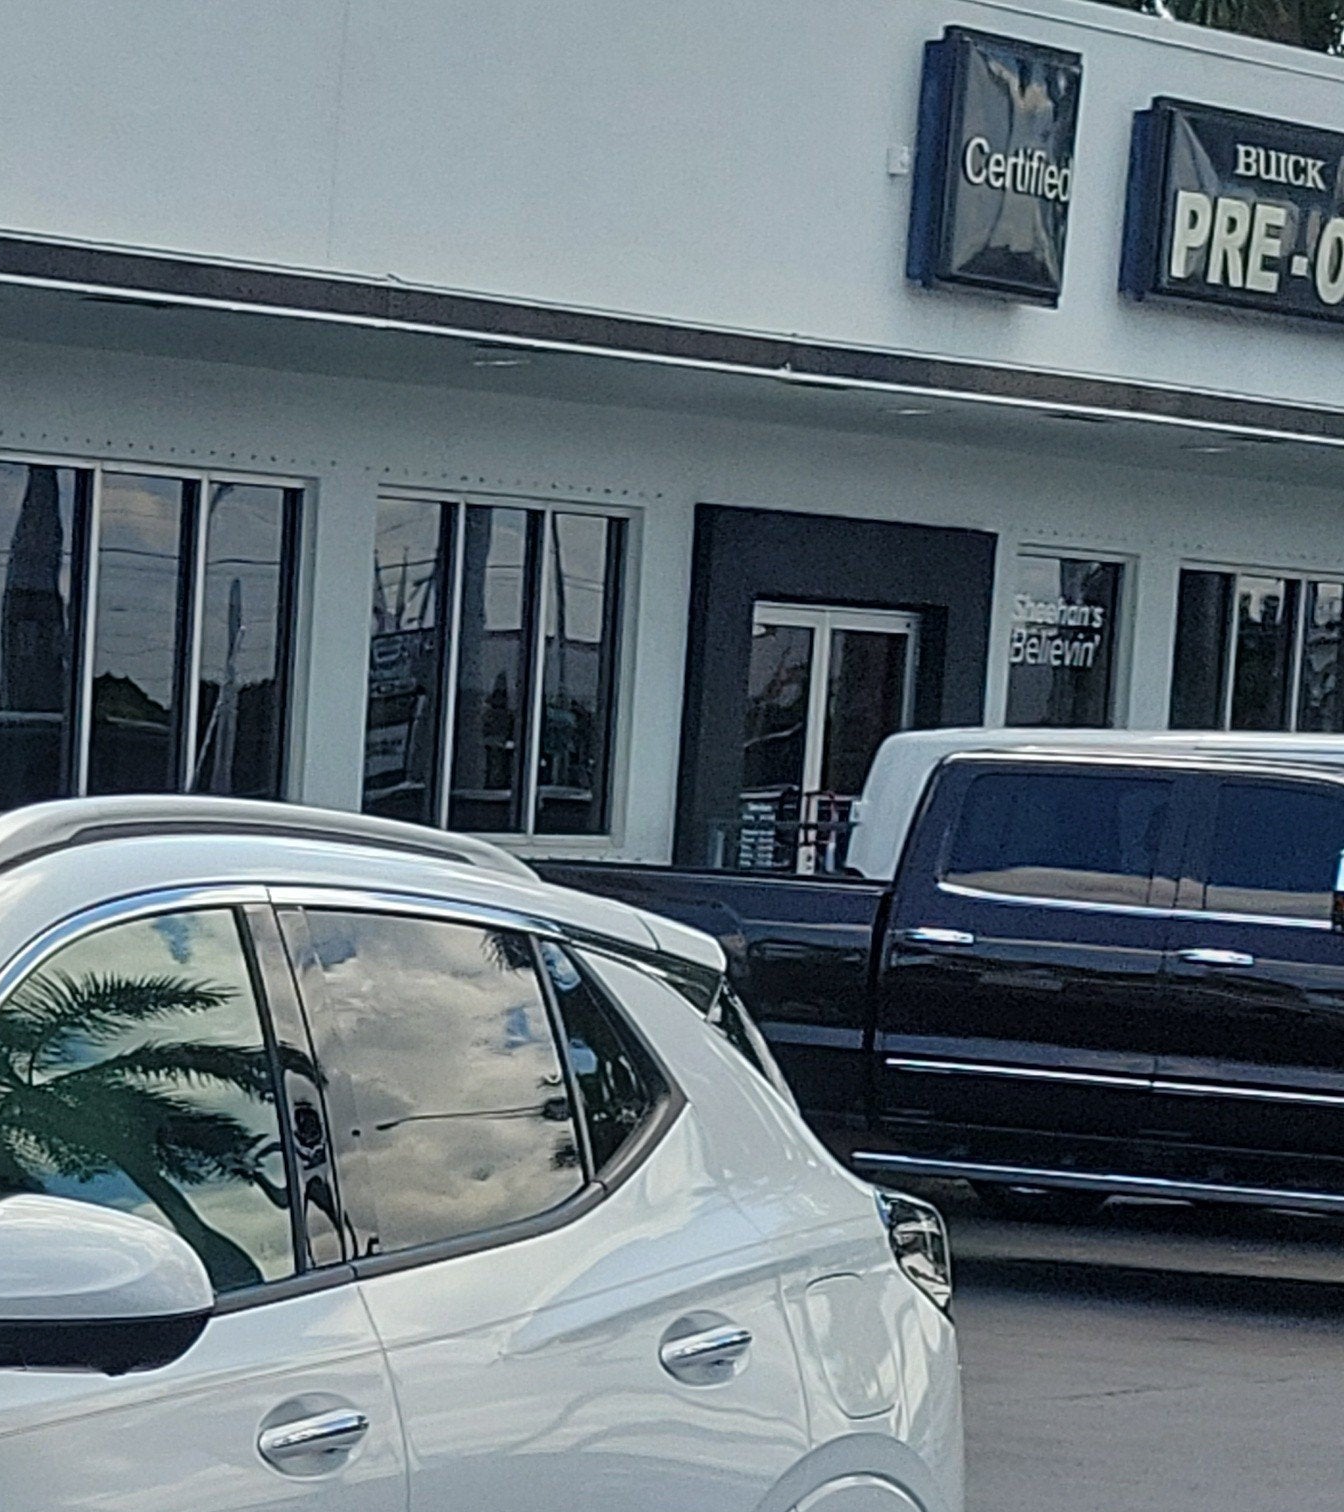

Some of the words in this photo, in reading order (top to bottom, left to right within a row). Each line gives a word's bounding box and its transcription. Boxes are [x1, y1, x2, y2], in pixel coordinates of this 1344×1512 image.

[964, 136, 1075, 202] Certified
[1234, 143, 1326, 191] BUICK
[1009, 628, 1101, 668] Believin'
